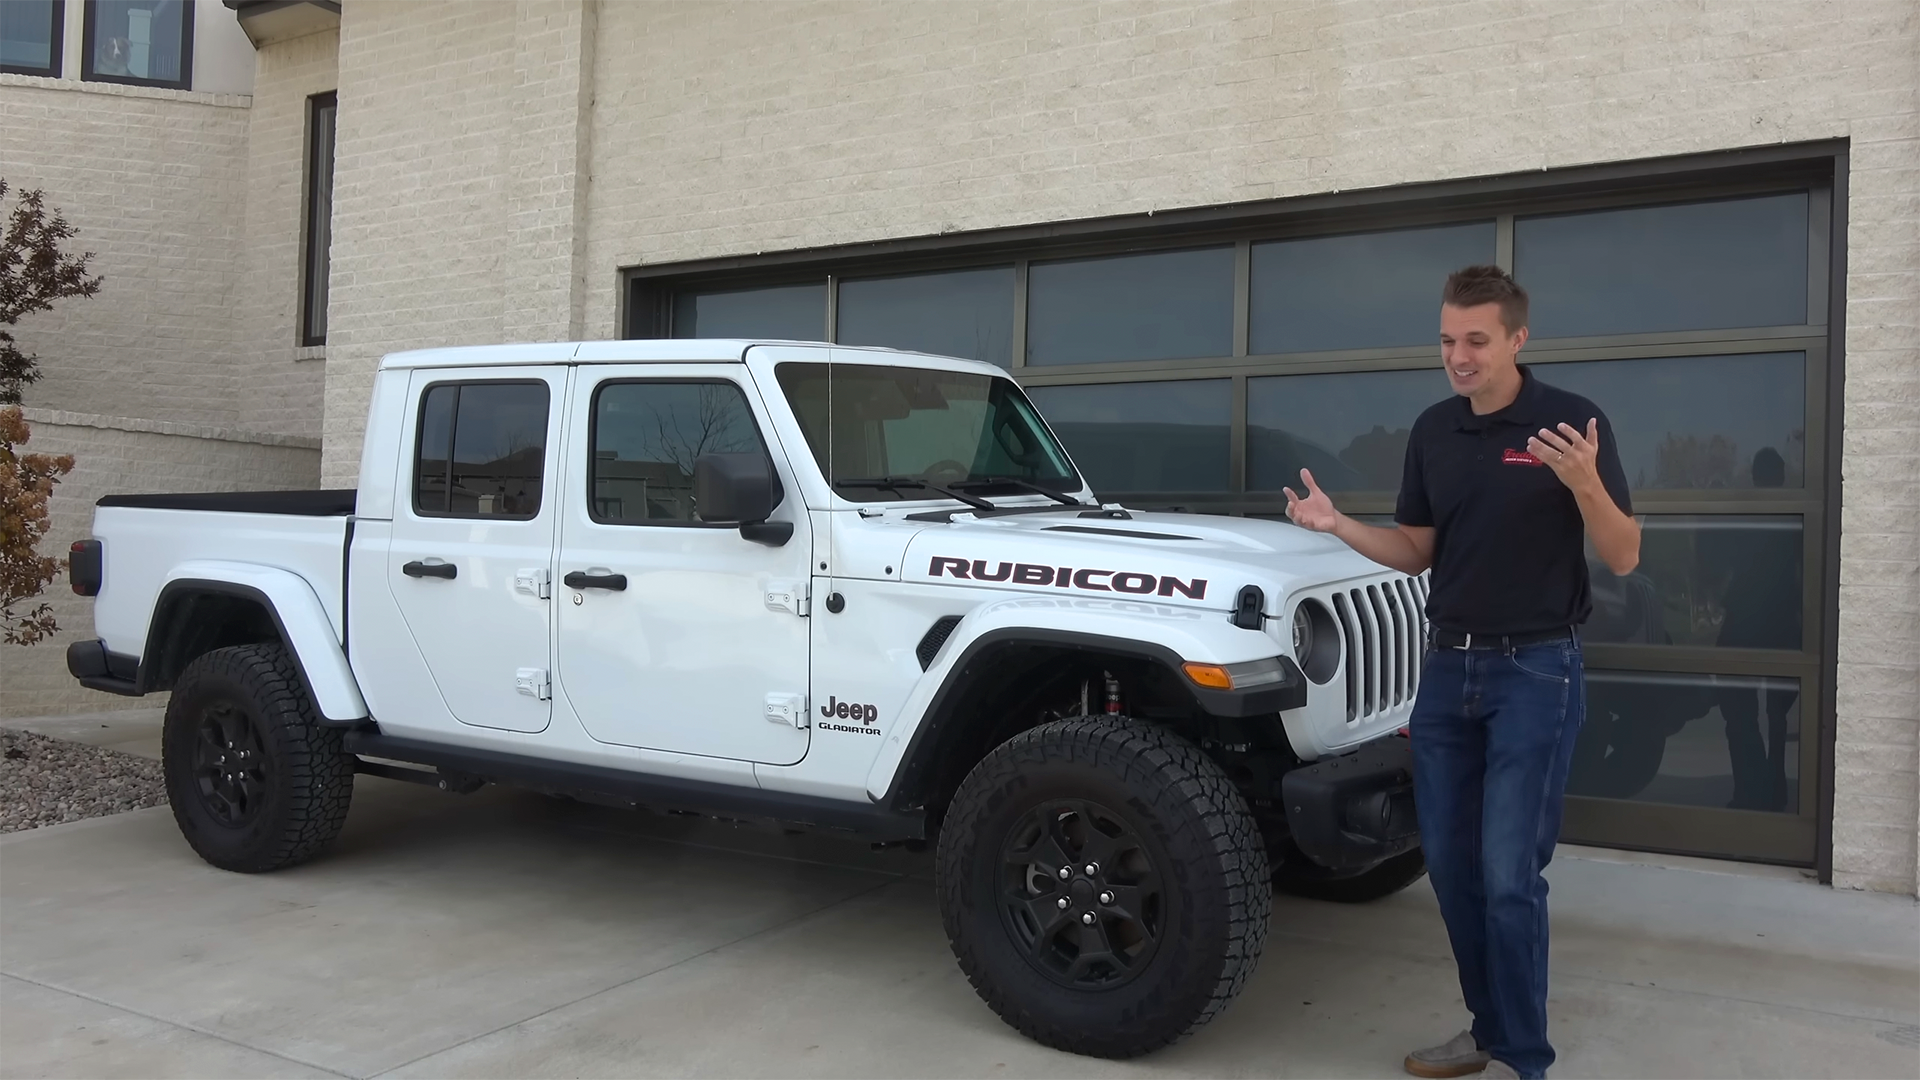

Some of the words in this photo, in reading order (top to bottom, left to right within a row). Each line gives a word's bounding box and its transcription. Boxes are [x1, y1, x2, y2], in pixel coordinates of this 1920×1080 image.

[928, 556, 1208, 600] RUBICON
[820, 695, 878, 726] Jeep
[818, 722, 882, 736] GLADIATOR
